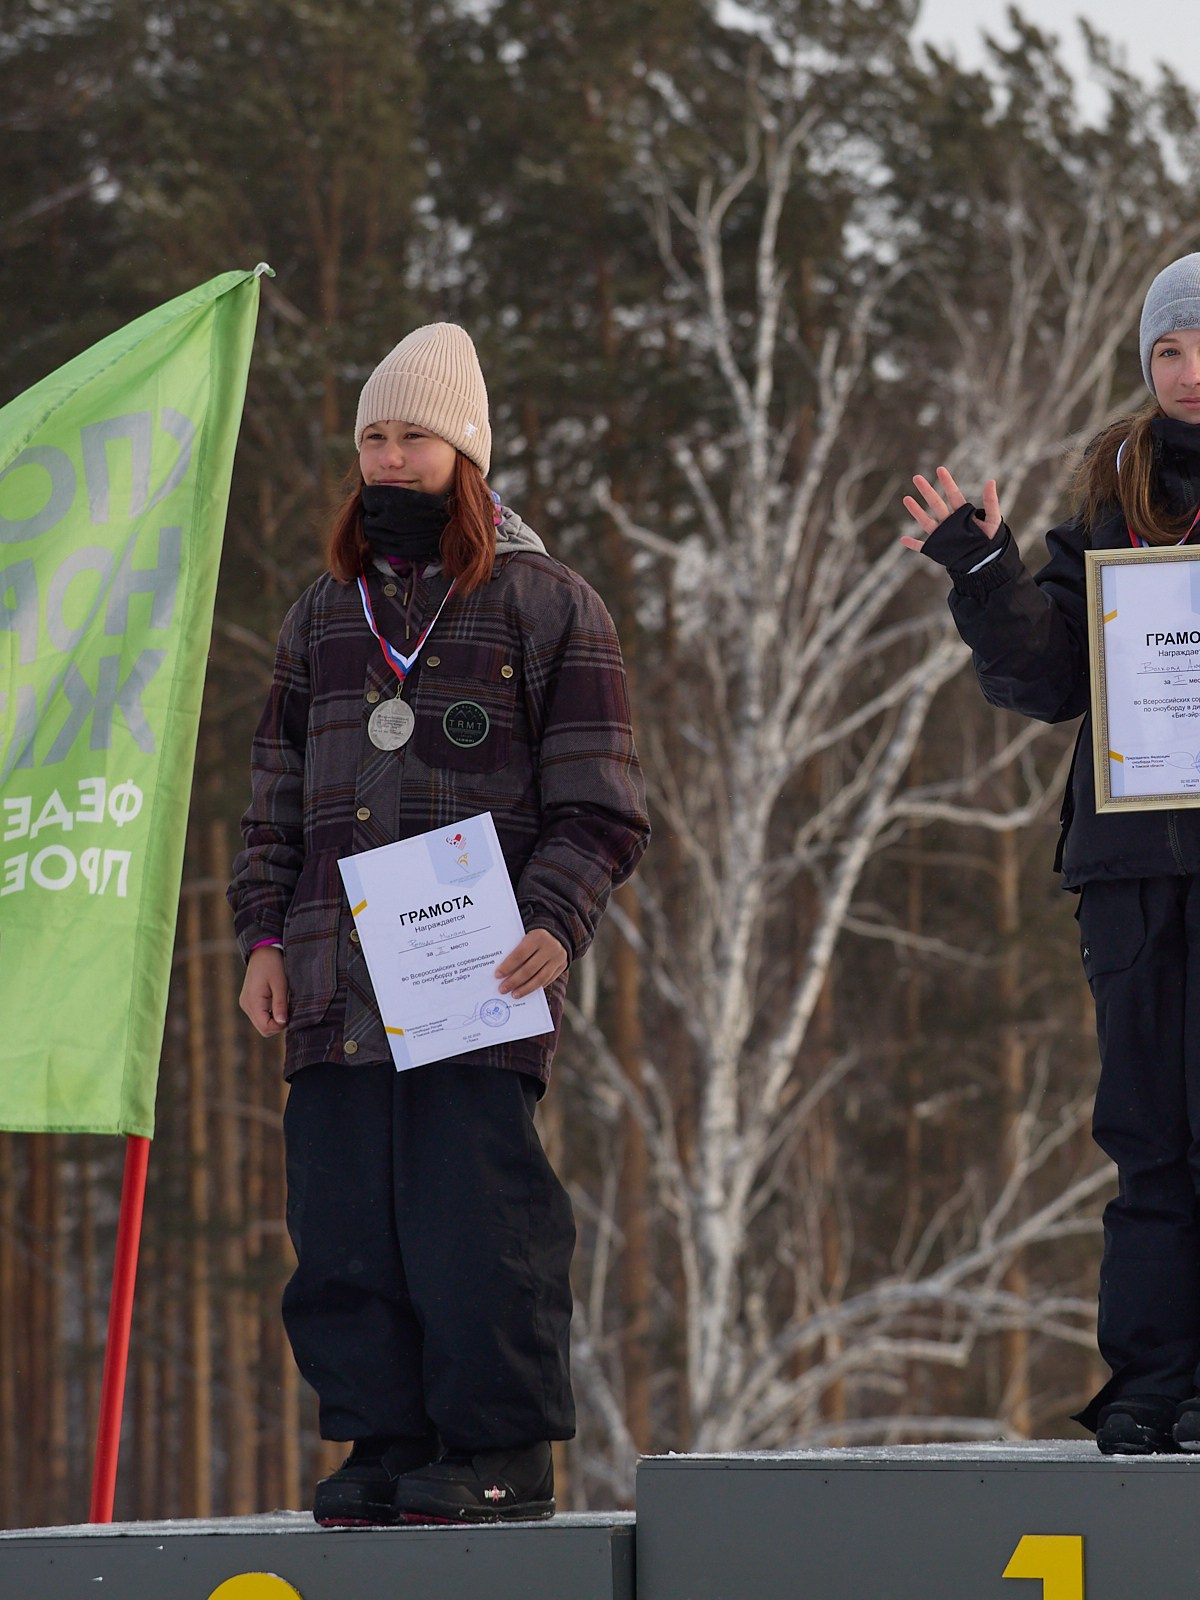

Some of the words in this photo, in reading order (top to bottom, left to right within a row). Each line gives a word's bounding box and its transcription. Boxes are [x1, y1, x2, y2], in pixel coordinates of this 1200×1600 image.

[1142, 696, 1190, 706] Всероссийских
[1152, 704, 1185, 712] сноуборду
[400, 894, 474, 926] ГРАМОТА
[414, 914, 466, 933] Награждается
[450, 942, 469, 950] место
